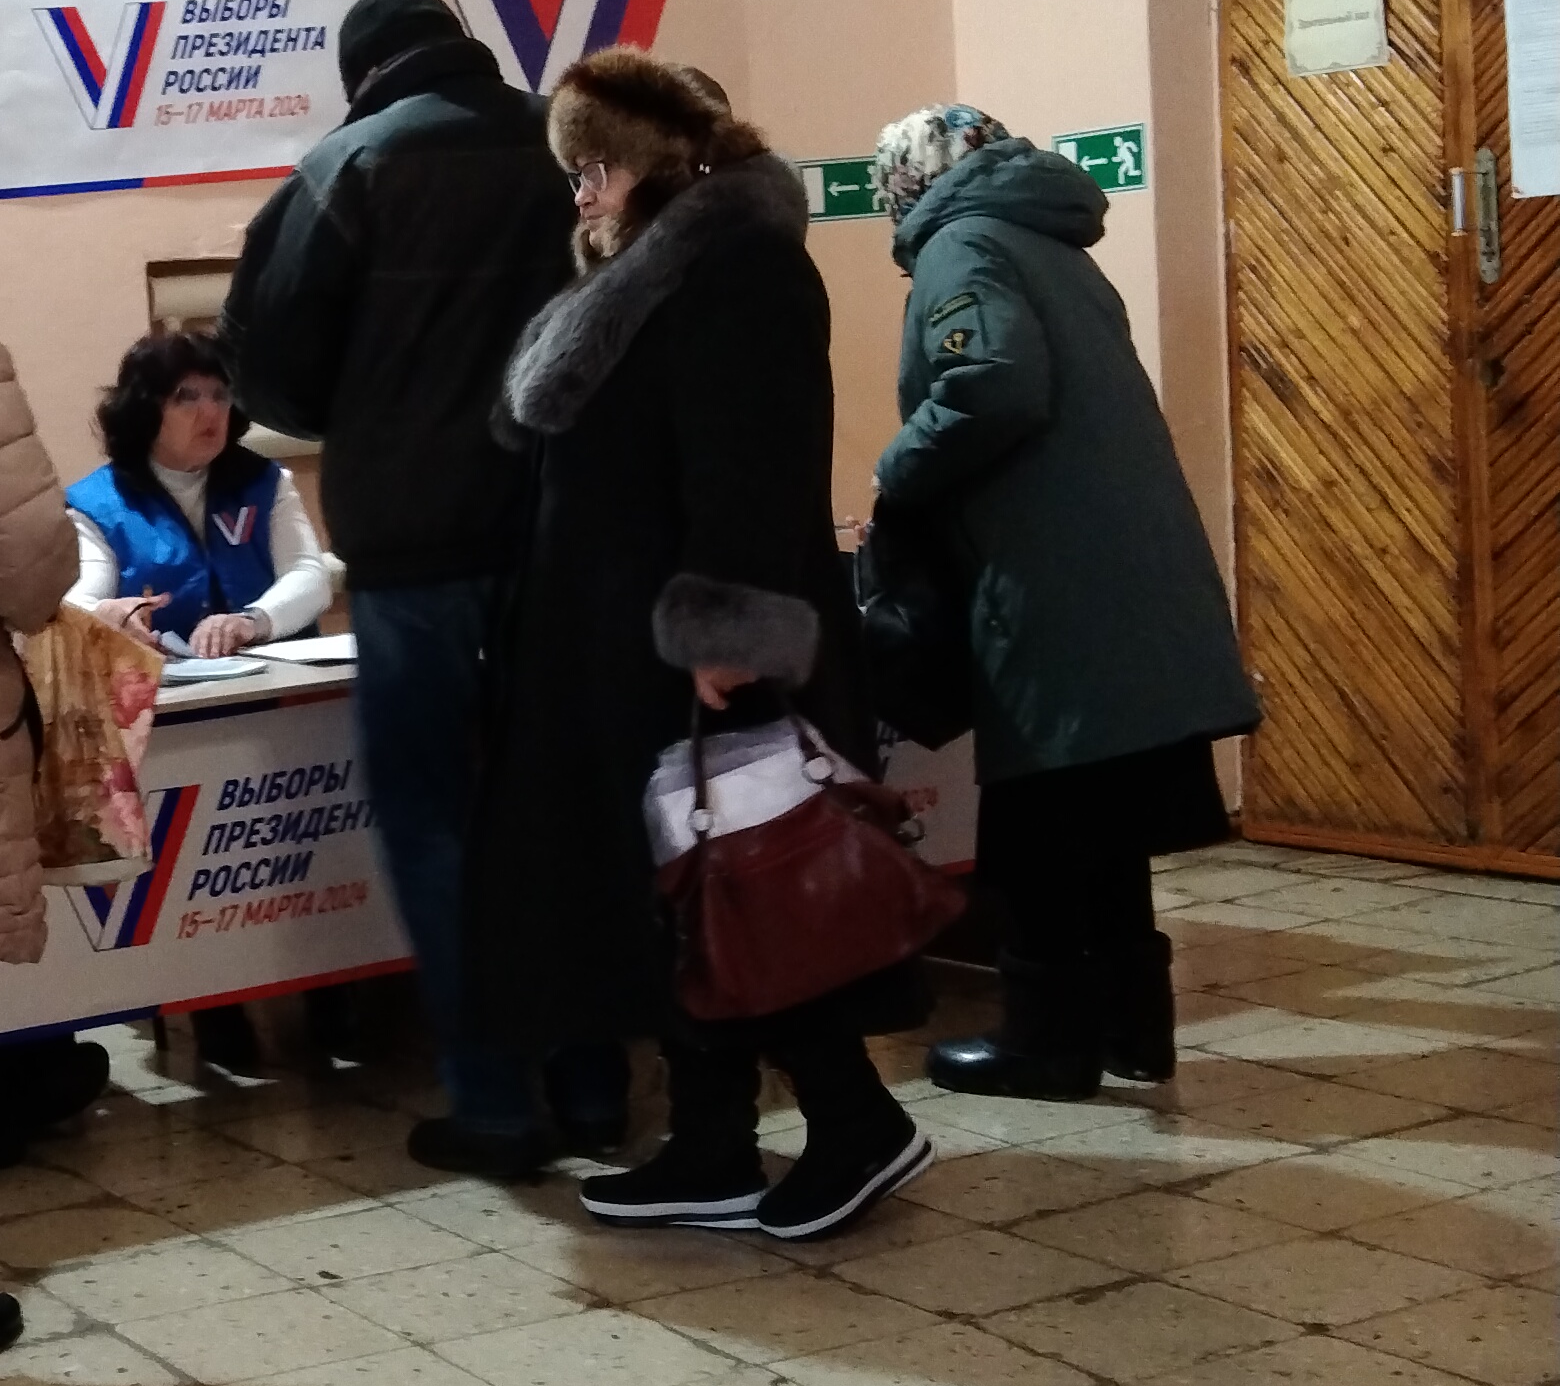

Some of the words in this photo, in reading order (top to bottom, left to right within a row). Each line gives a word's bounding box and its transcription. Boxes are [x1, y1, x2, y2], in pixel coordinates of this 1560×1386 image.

[170, 26, 327, 60] ПРЕЗИДЕНТА
[161, 65, 262, 95] РОССИИ
[205, 98, 265, 122] МАРТА
[267, 94, 310, 118] 2024
[217, 760, 353, 811] ВЫБОРЫ
[202, 799, 376, 856] ПРЕЗИДЕНТ
[188, 851, 314, 901] РОССИИ
[241, 891, 315, 928] МАРТА
[318, 880, 368, 913] 2024
